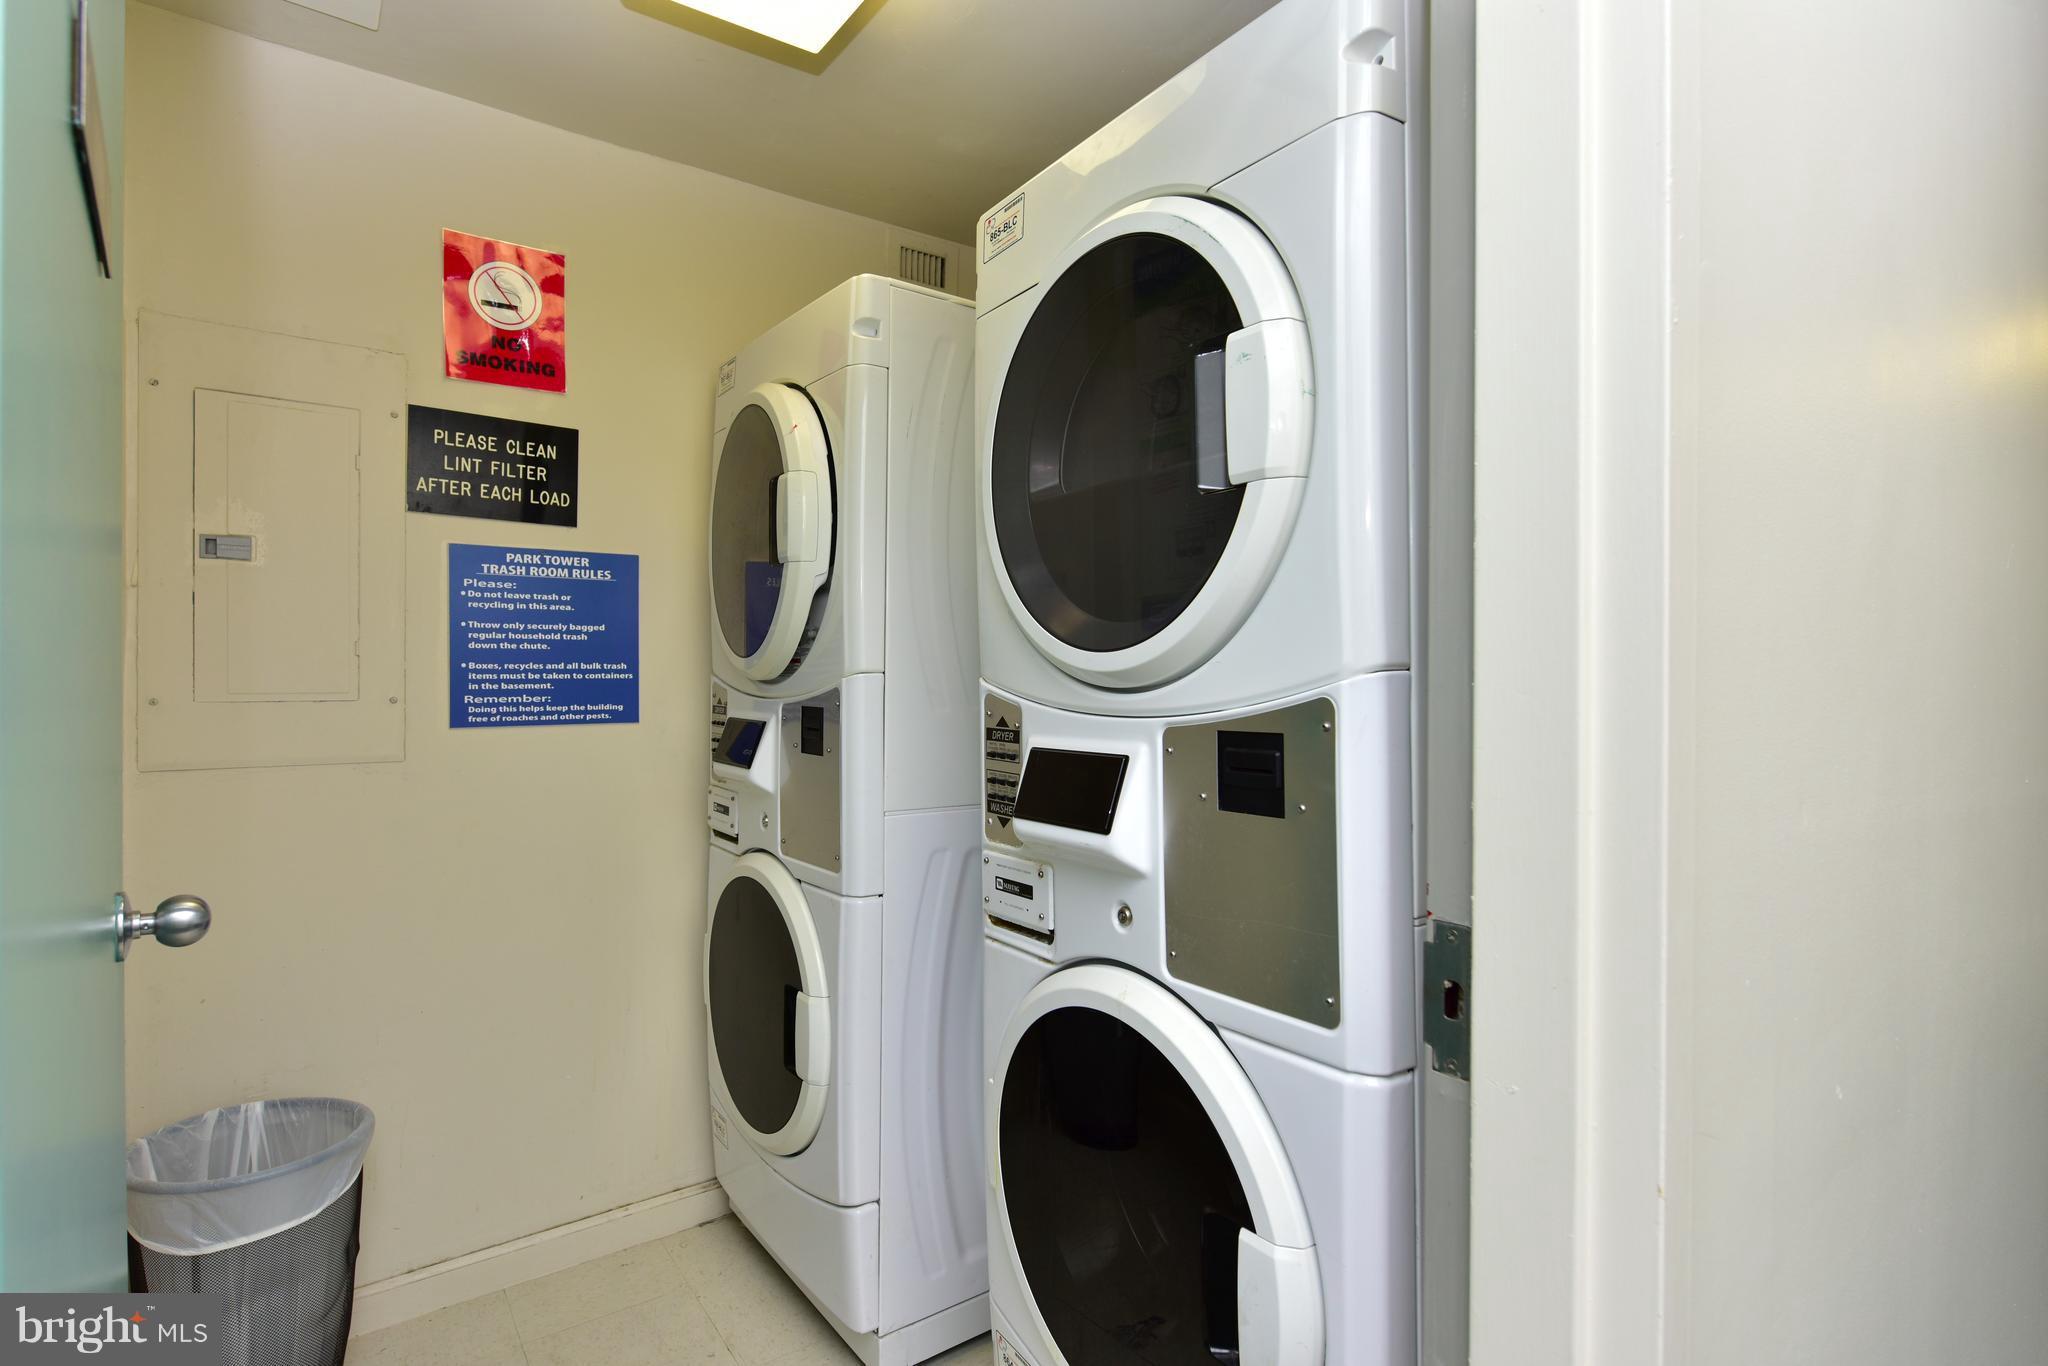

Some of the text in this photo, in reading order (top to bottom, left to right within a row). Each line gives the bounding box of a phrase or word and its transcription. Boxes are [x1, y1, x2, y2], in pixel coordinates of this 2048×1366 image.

[491, 335, 522, 352] NO
[457, 350, 556, 377] SMOKING
[434, 428, 557, 460] PLEASE CLEAN
[444, 455, 547, 481] LINT FILTER
[416, 476, 570, 507] AFTER EACH LOAD
[506, 553, 589, 567] PARK TOWER
[481, 564, 611, 580] TRASH ROOM RULES
[463, 578, 517, 589] Please:
[468, 590, 481, 598] Do
[484, 591, 502, 599] not
[533, 593, 559, 601] trash
[468, 601, 514, 610] recycling
[529, 602, 548, 610] this
[468, 620, 606, 632] Throw only securely bagged
[468, 631, 507, 640] regular
[508, 632, 561, 640] household
[468, 641, 497, 649] down
[519, 642, 551, 650] chute.
[468, 662, 502, 670] Boxes,
[504, 662, 544, 670] recycles
[468, 682, 554, 690] in the basement.
[464, 694, 551, 704] Remember:
[468, 706, 497, 714] Doing
[519, 705, 544, 713] helps
[546, 704, 568, 712] keep
[468, 715, 489, 723] free
[992, 730, 1014, 742] DRYER
[990, 802, 1015, 816] WASHE
